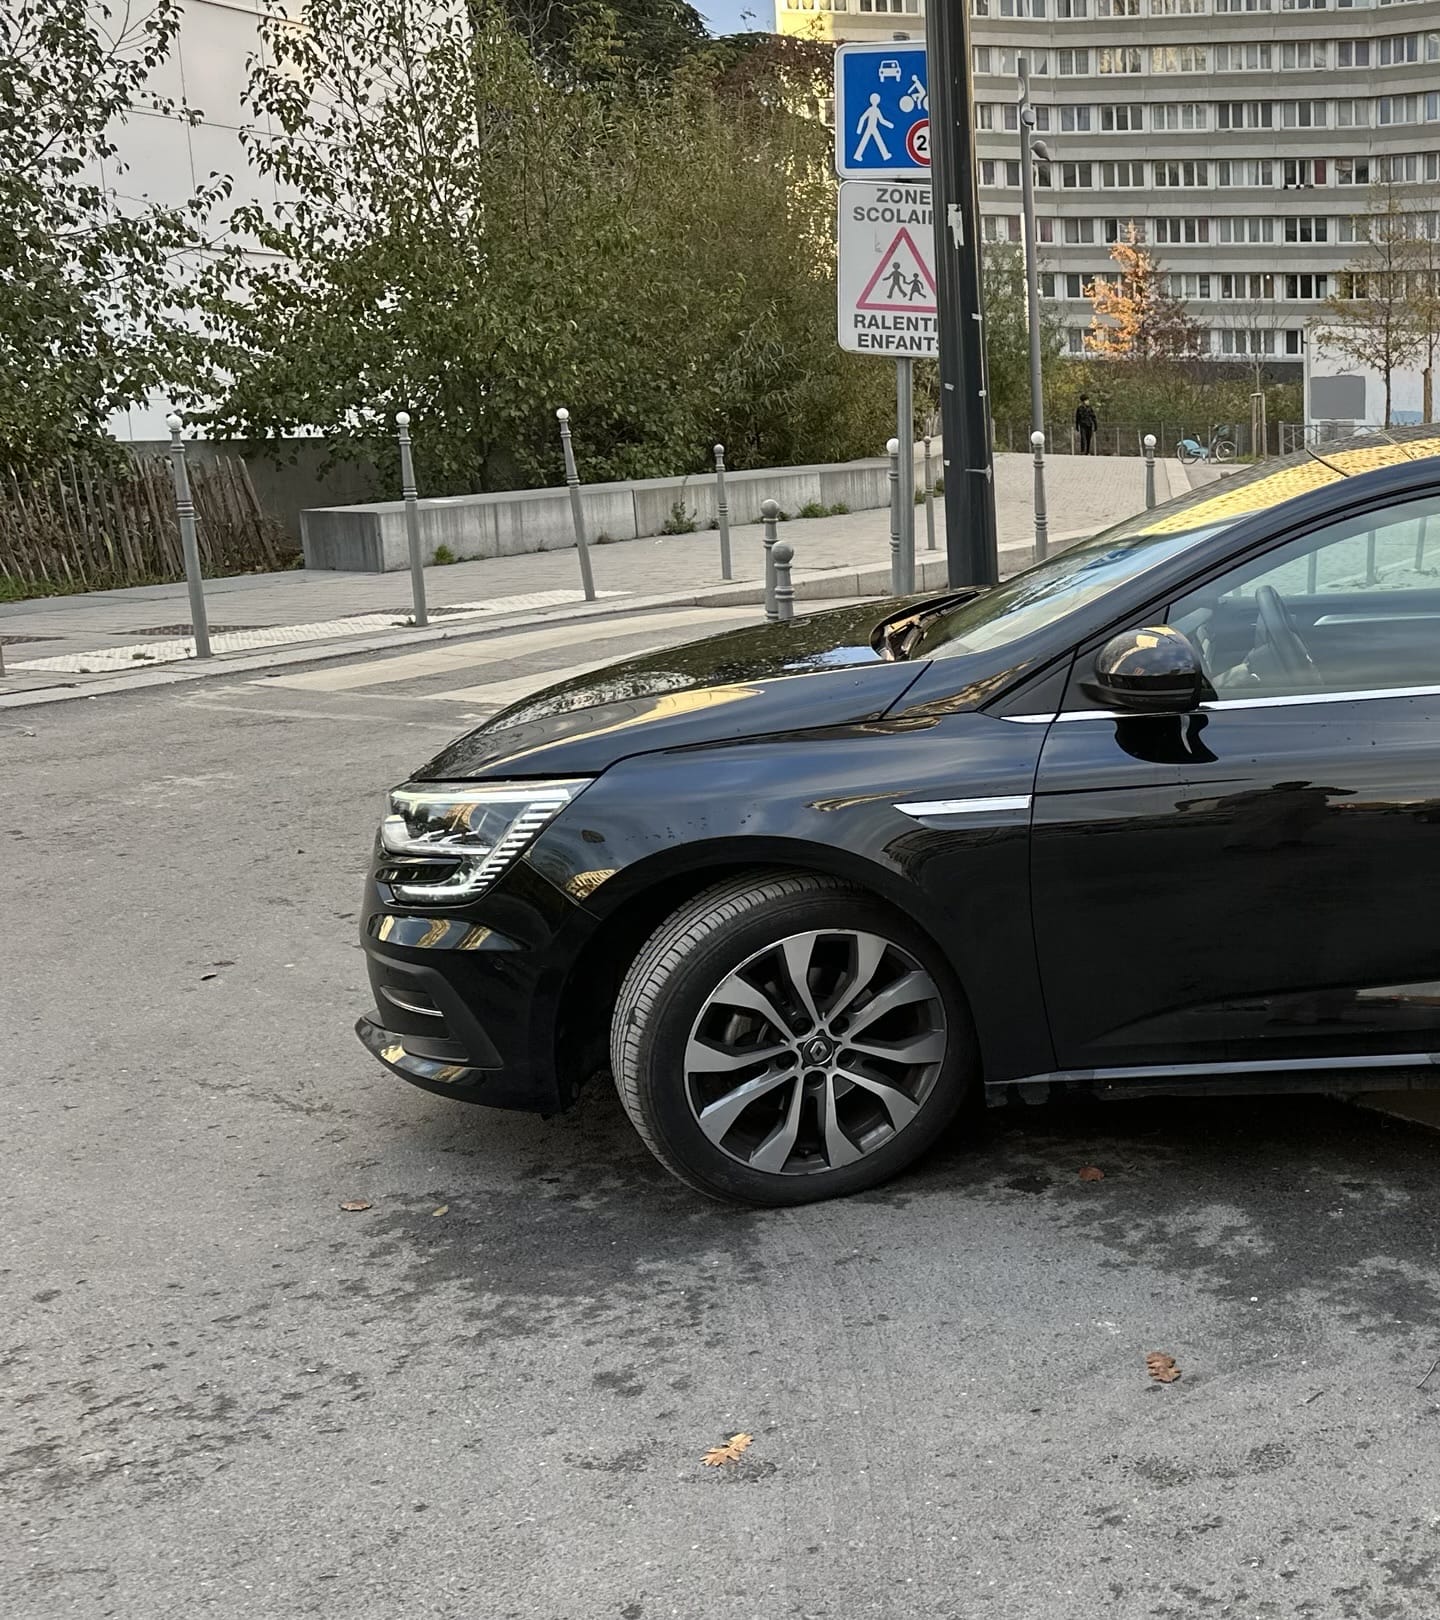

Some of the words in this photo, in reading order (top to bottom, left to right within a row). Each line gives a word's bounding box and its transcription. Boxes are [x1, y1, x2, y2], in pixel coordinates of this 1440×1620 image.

[916, 134, 929, 151] 2
[876, 187, 931, 205] ZONE
[857, 333, 939, 351] ENFANT
